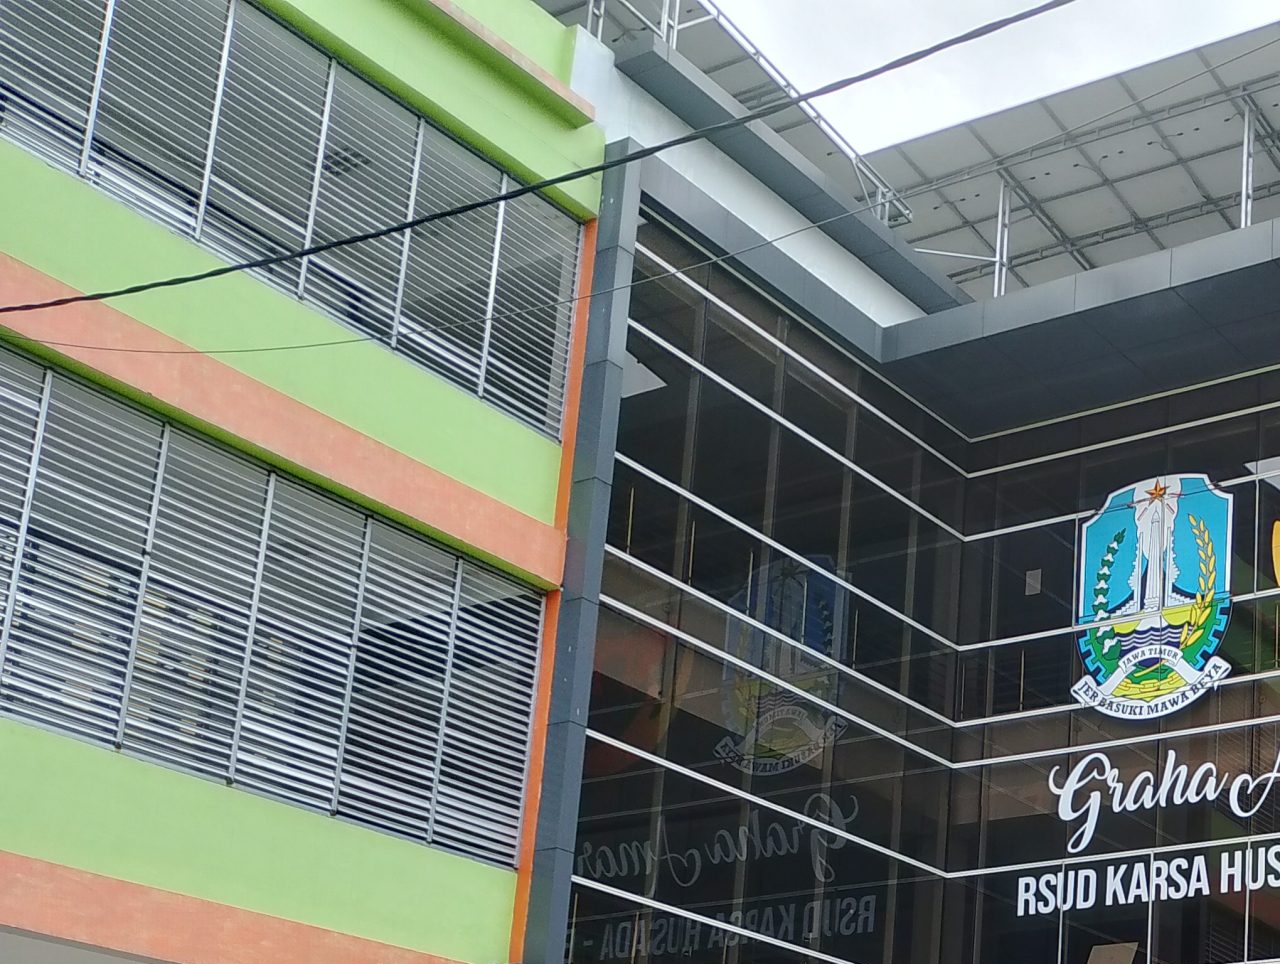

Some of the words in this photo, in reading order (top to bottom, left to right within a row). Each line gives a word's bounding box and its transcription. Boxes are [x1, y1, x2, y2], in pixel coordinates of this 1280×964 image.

[1122, 649, 1147, 667] JAWA
[1147, 647, 1179, 661] TIMUR
[1077, 680, 1099, 703] JER
[1100, 699, 1144, 716] BASUKI
[1147, 691, 1191, 715] MAWA
[1191, 663, 1222, 694] BEYA
[1049, 749, 1229, 853] Graha
[1017, 868, 1097, 916] RSUD
[1105, 855, 1210, 906] KARSA
